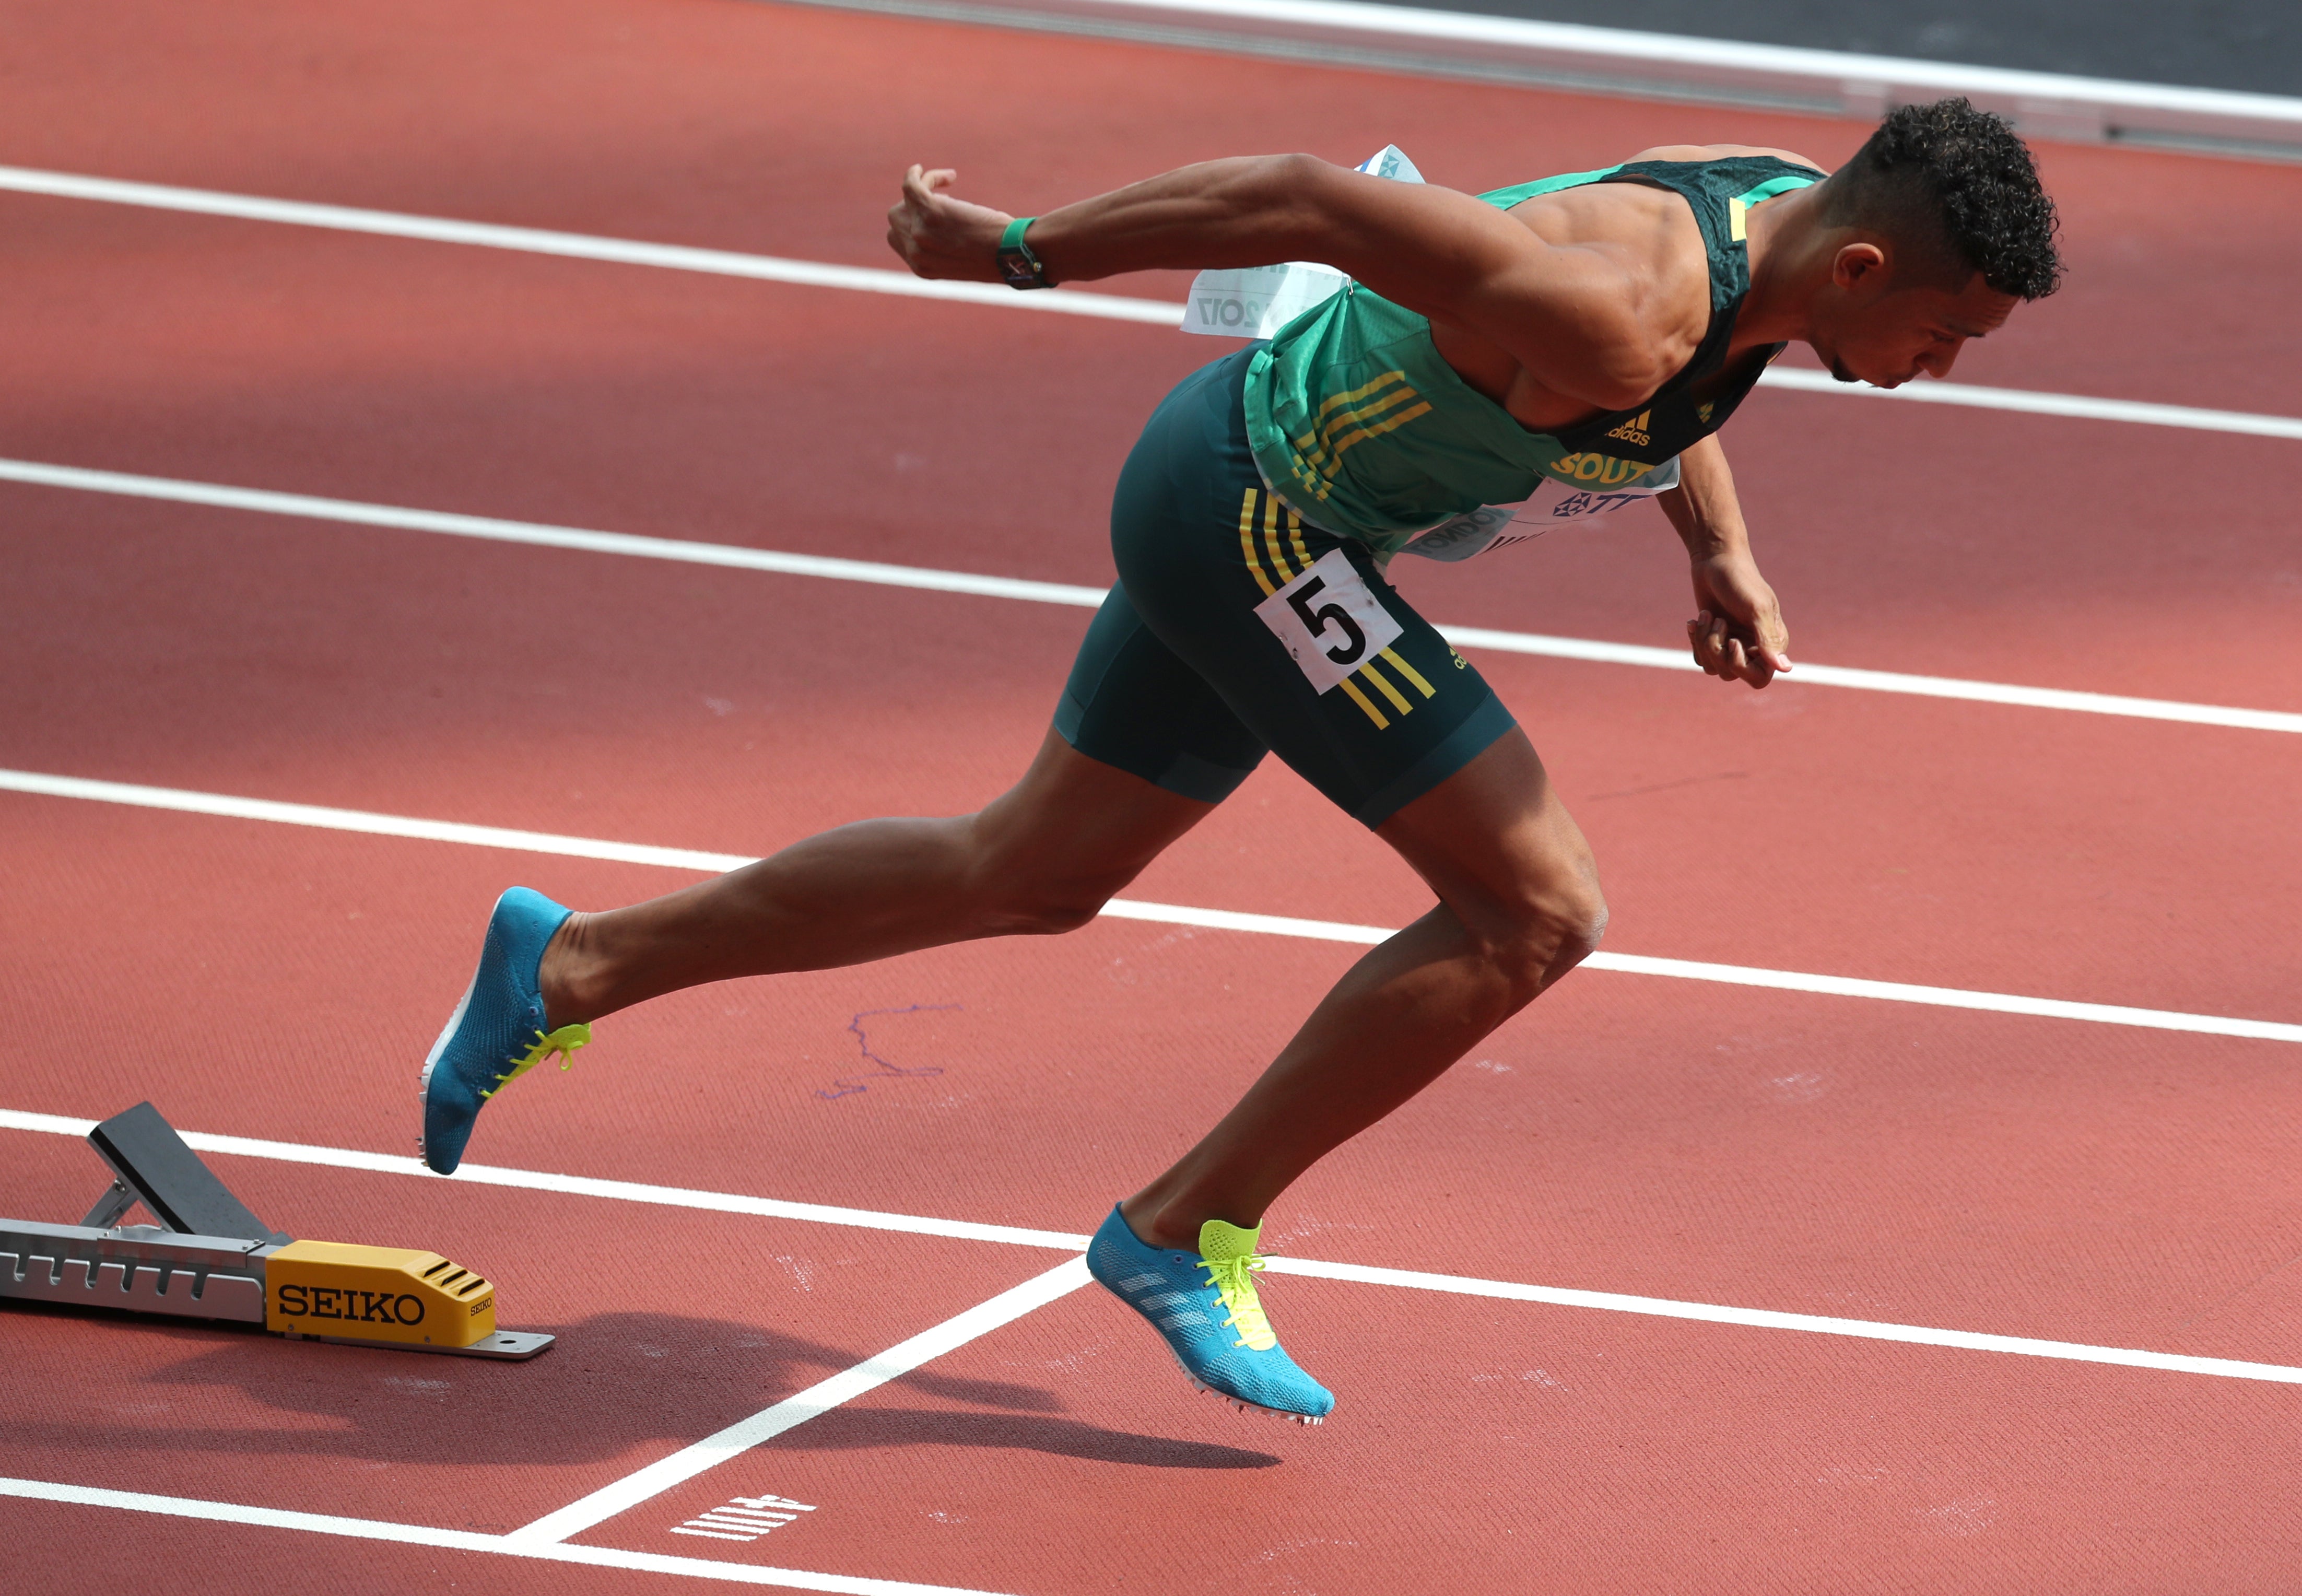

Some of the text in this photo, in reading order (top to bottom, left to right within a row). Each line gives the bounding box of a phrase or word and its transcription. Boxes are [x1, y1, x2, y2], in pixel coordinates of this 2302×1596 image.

[1604, 425, 1650, 446] didas
[1286, 576, 1366, 665] 5
[278, 1284, 425, 1326] SEIKO
[471, 1297, 492, 1317] SEIKO
